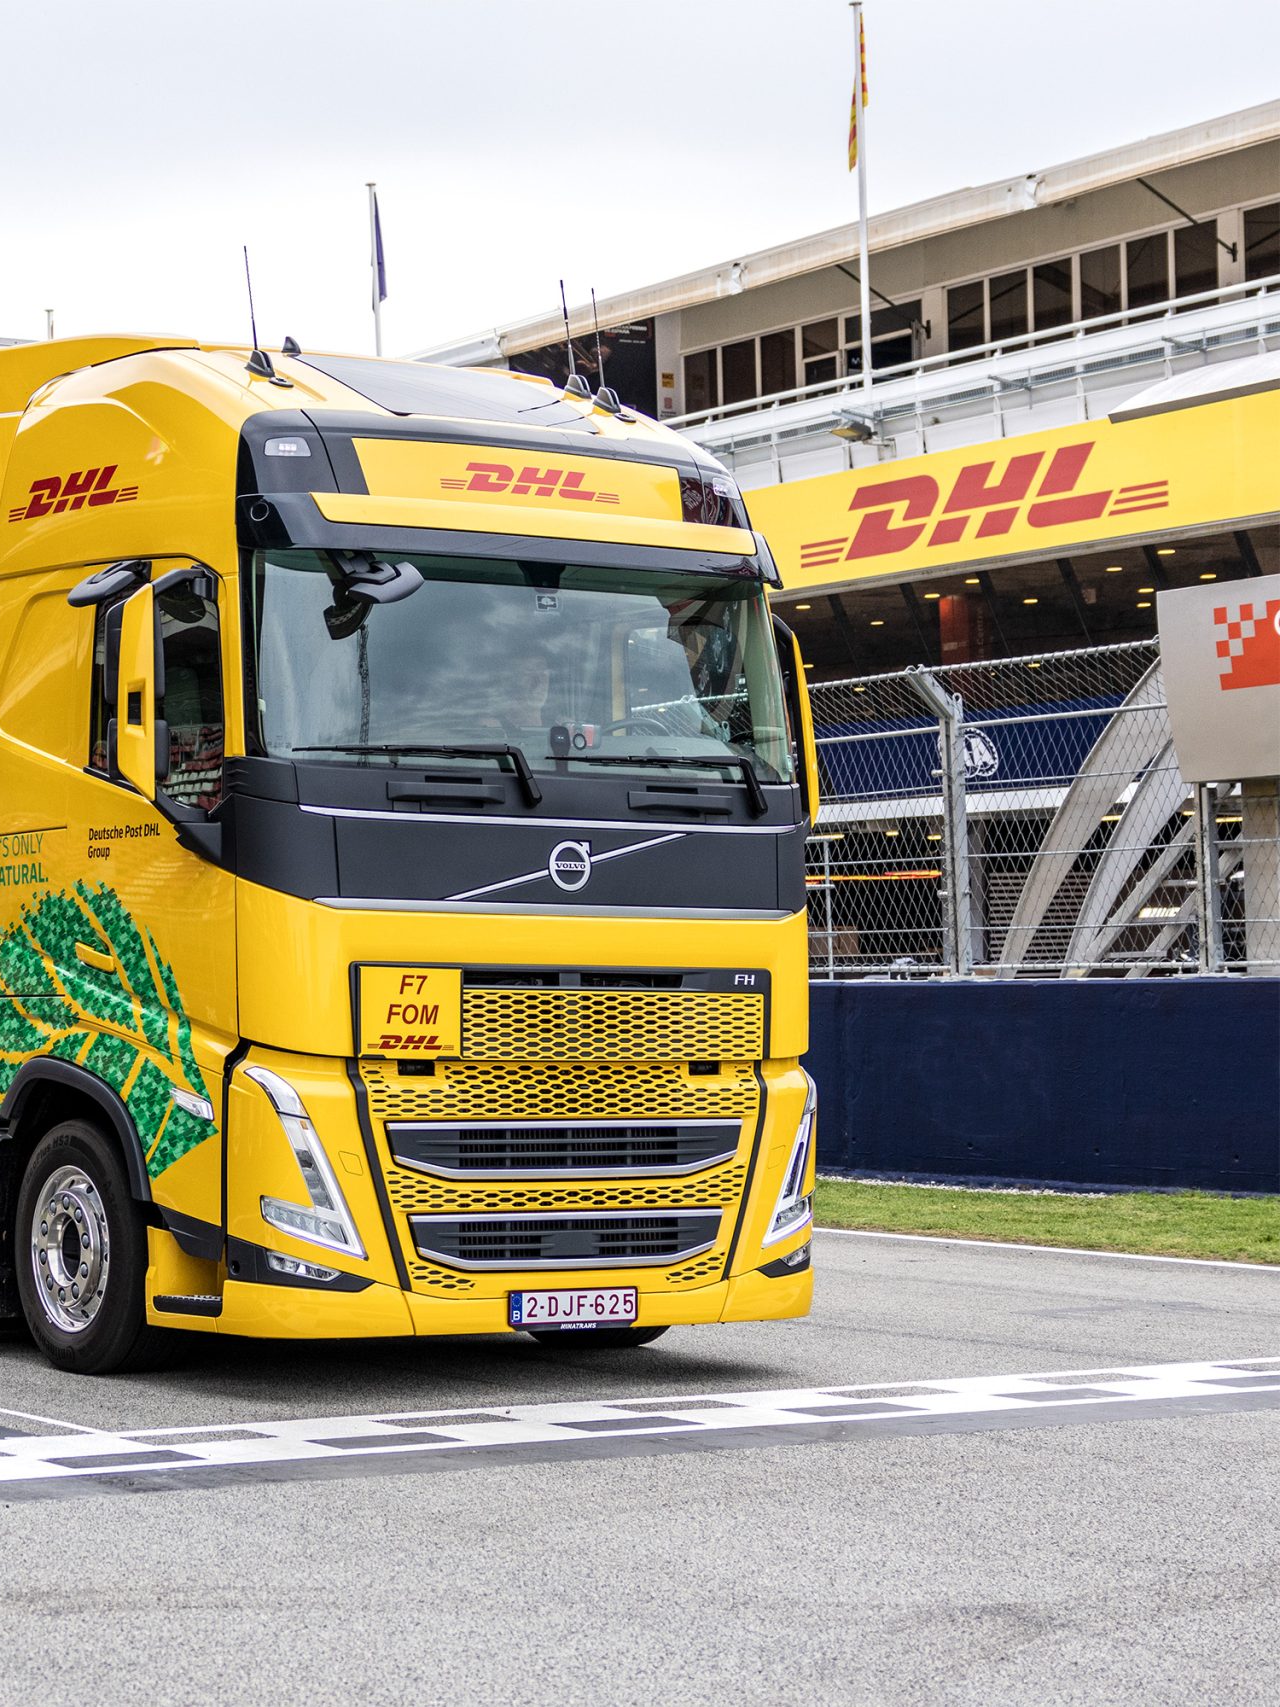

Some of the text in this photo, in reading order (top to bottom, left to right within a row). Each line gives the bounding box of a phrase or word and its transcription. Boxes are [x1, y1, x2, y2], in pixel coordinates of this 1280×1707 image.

[22, 464, 122, 520] DHL
[462, 462, 600, 502] DHL
[840, 441, 1118, 562] DHL
[88, 822, 161, 841] Deutsche Post DHL
[11, 833, 44, 857] ONLY
[87, 846, 111, 860] Group
[399, 974, 428, 995] F7
[734, 974, 755, 986] FH
[386, 1003, 439, 1025] FOM
[375, 1034, 445, 1051] DHL
[512, 1293, 634, 1321] B 2-DJF-625
